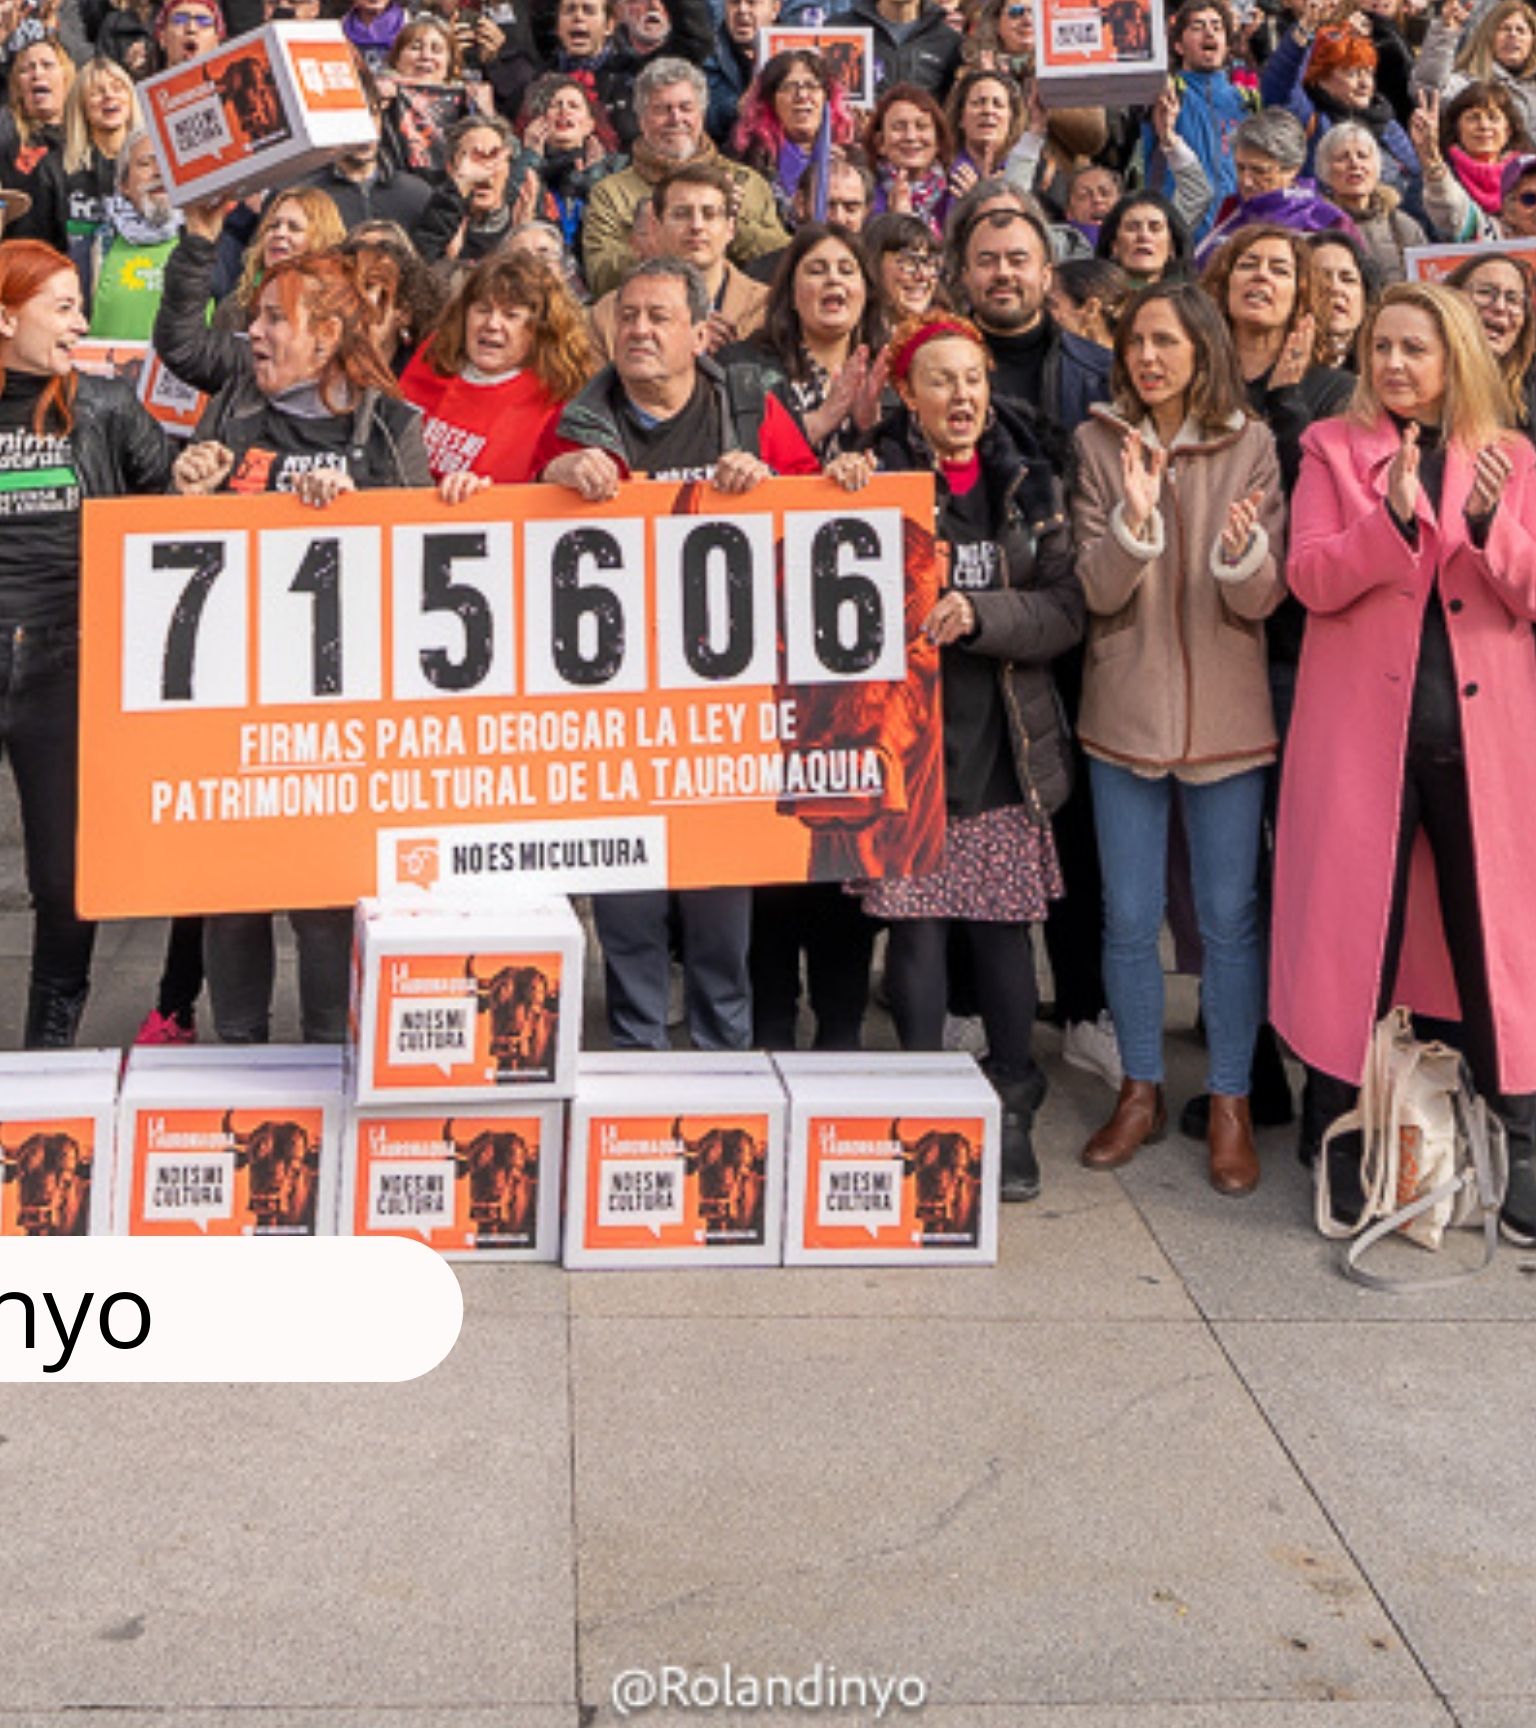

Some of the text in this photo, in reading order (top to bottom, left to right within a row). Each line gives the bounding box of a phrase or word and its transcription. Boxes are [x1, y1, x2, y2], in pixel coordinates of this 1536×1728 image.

[240, 699, 798, 764] FIRMAS PARA DEROGAR LA LEY DE
[151, 749, 884, 823] PATRIMONIO CULTURAL DE LA TAUROMAQUIA
[399, 1029, 466, 1053] CULTURA
[153, 1185, 224, 1208] CULTURA
[376, 1193, 445, 1216] CULTURA
[608, 1190, 675, 1212] CULTURA
[826, 1193, 893, 1212] CULTURA
